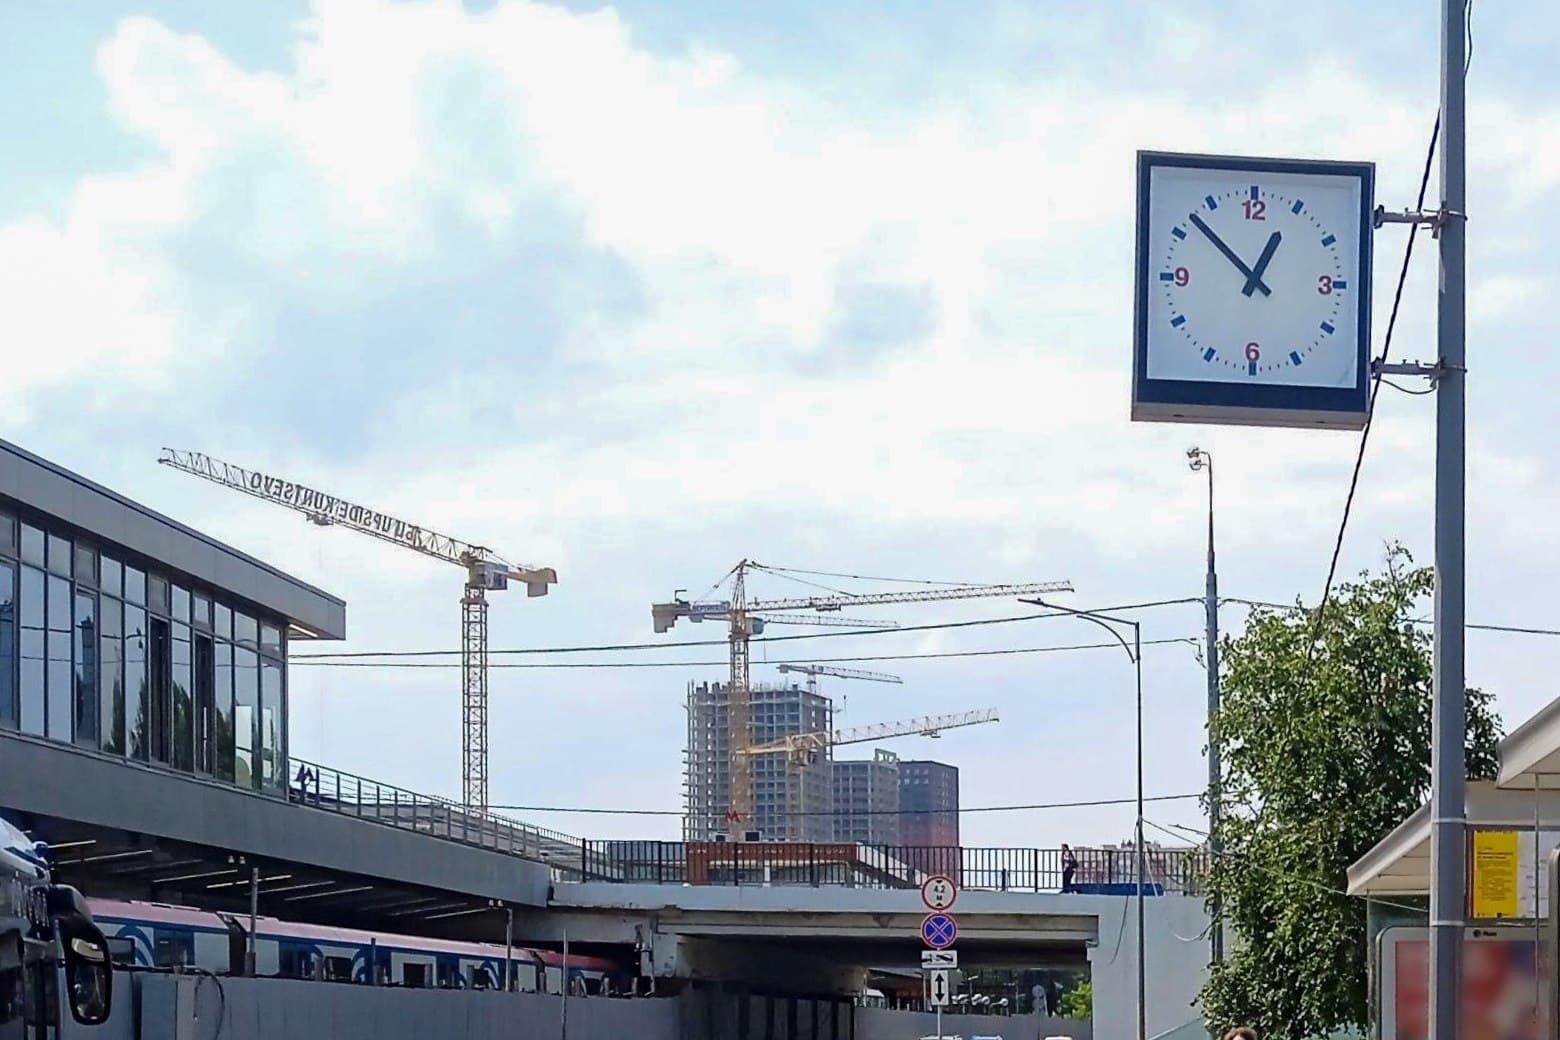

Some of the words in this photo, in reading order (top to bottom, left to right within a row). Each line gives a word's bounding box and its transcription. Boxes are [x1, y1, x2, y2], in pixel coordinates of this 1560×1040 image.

[1242, 200, 1266, 221] 12
[1174, 267, 1190, 287] 9
[1318, 275, 1333, 295] 3
[1245, 342, 1260, 362] 6
